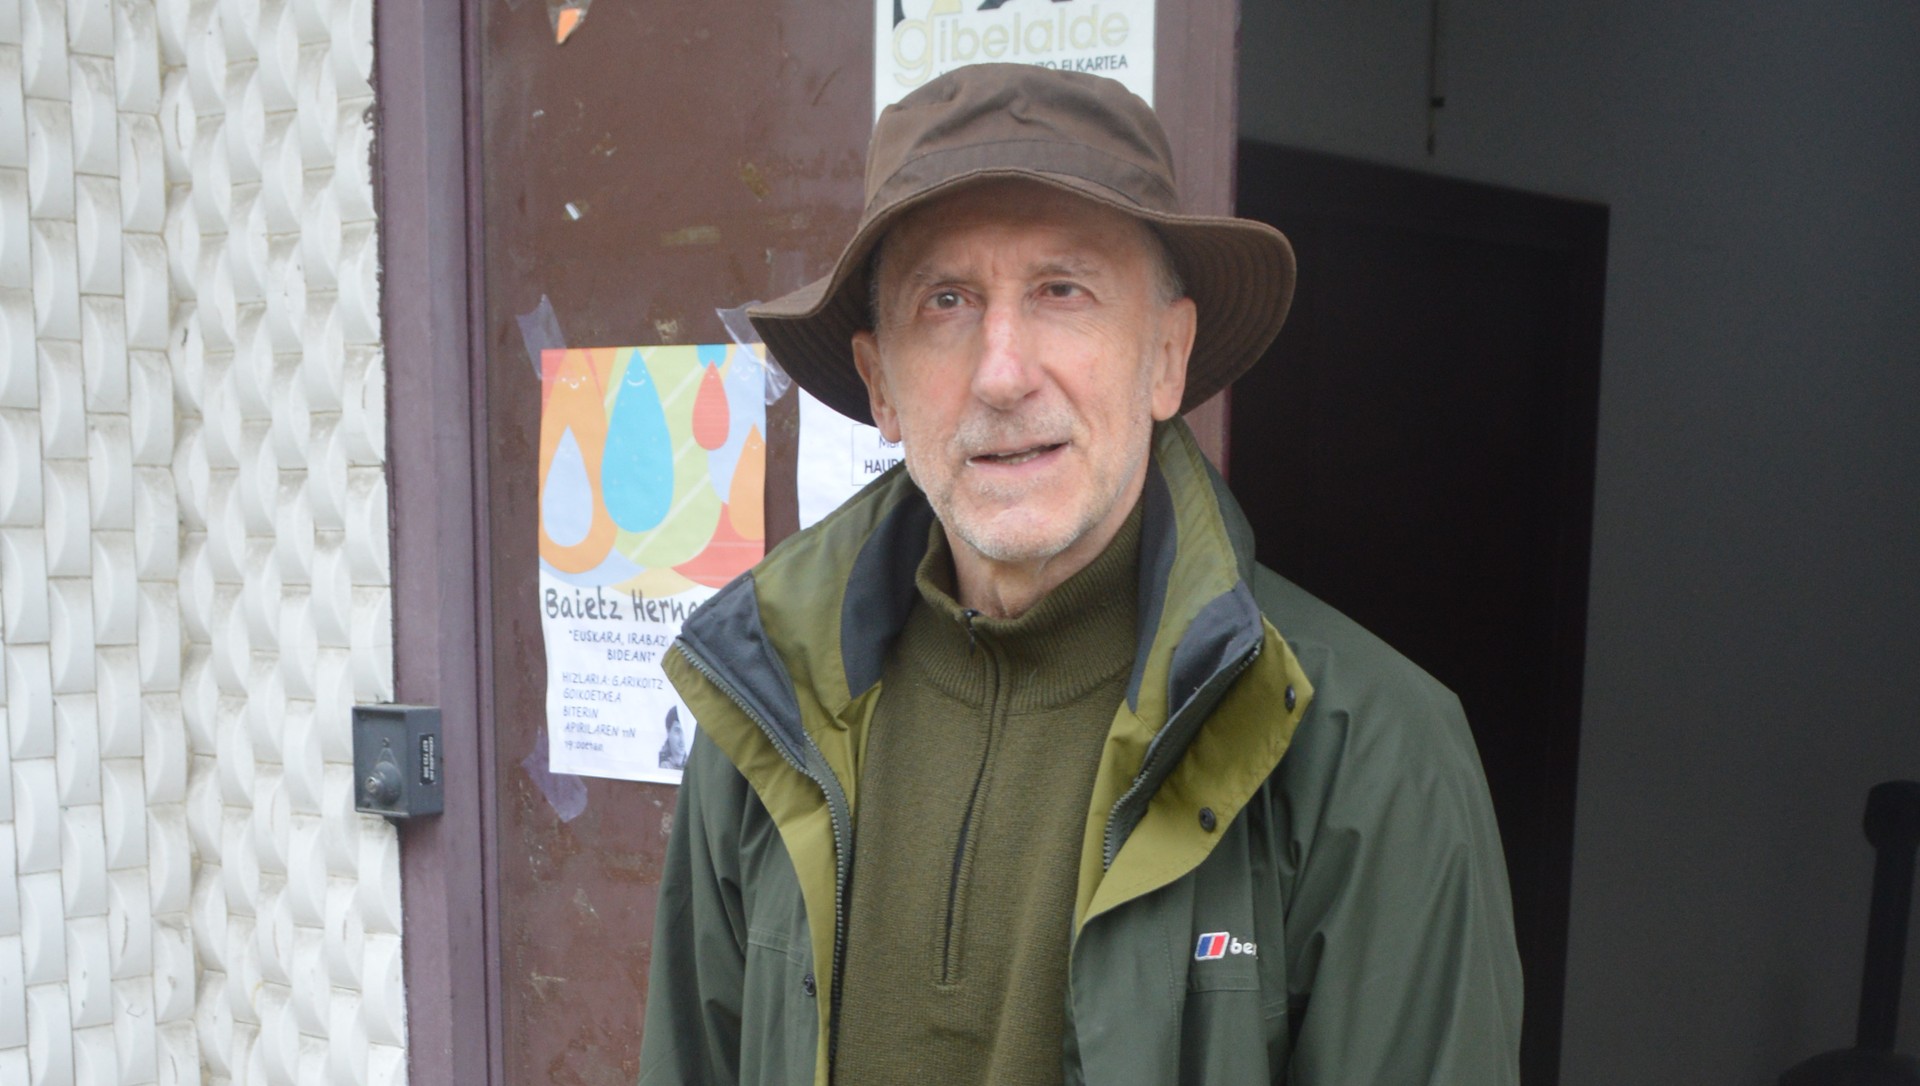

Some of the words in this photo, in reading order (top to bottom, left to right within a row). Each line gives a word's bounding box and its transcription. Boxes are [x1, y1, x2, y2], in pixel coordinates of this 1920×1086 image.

[892, 4, 1130, 86] gibelalde
[545, 585, 623, 620] Baietz
[563, 687, 622, 703] GOIKOETXEA
[563, 705, 599, 719] BITERIN
